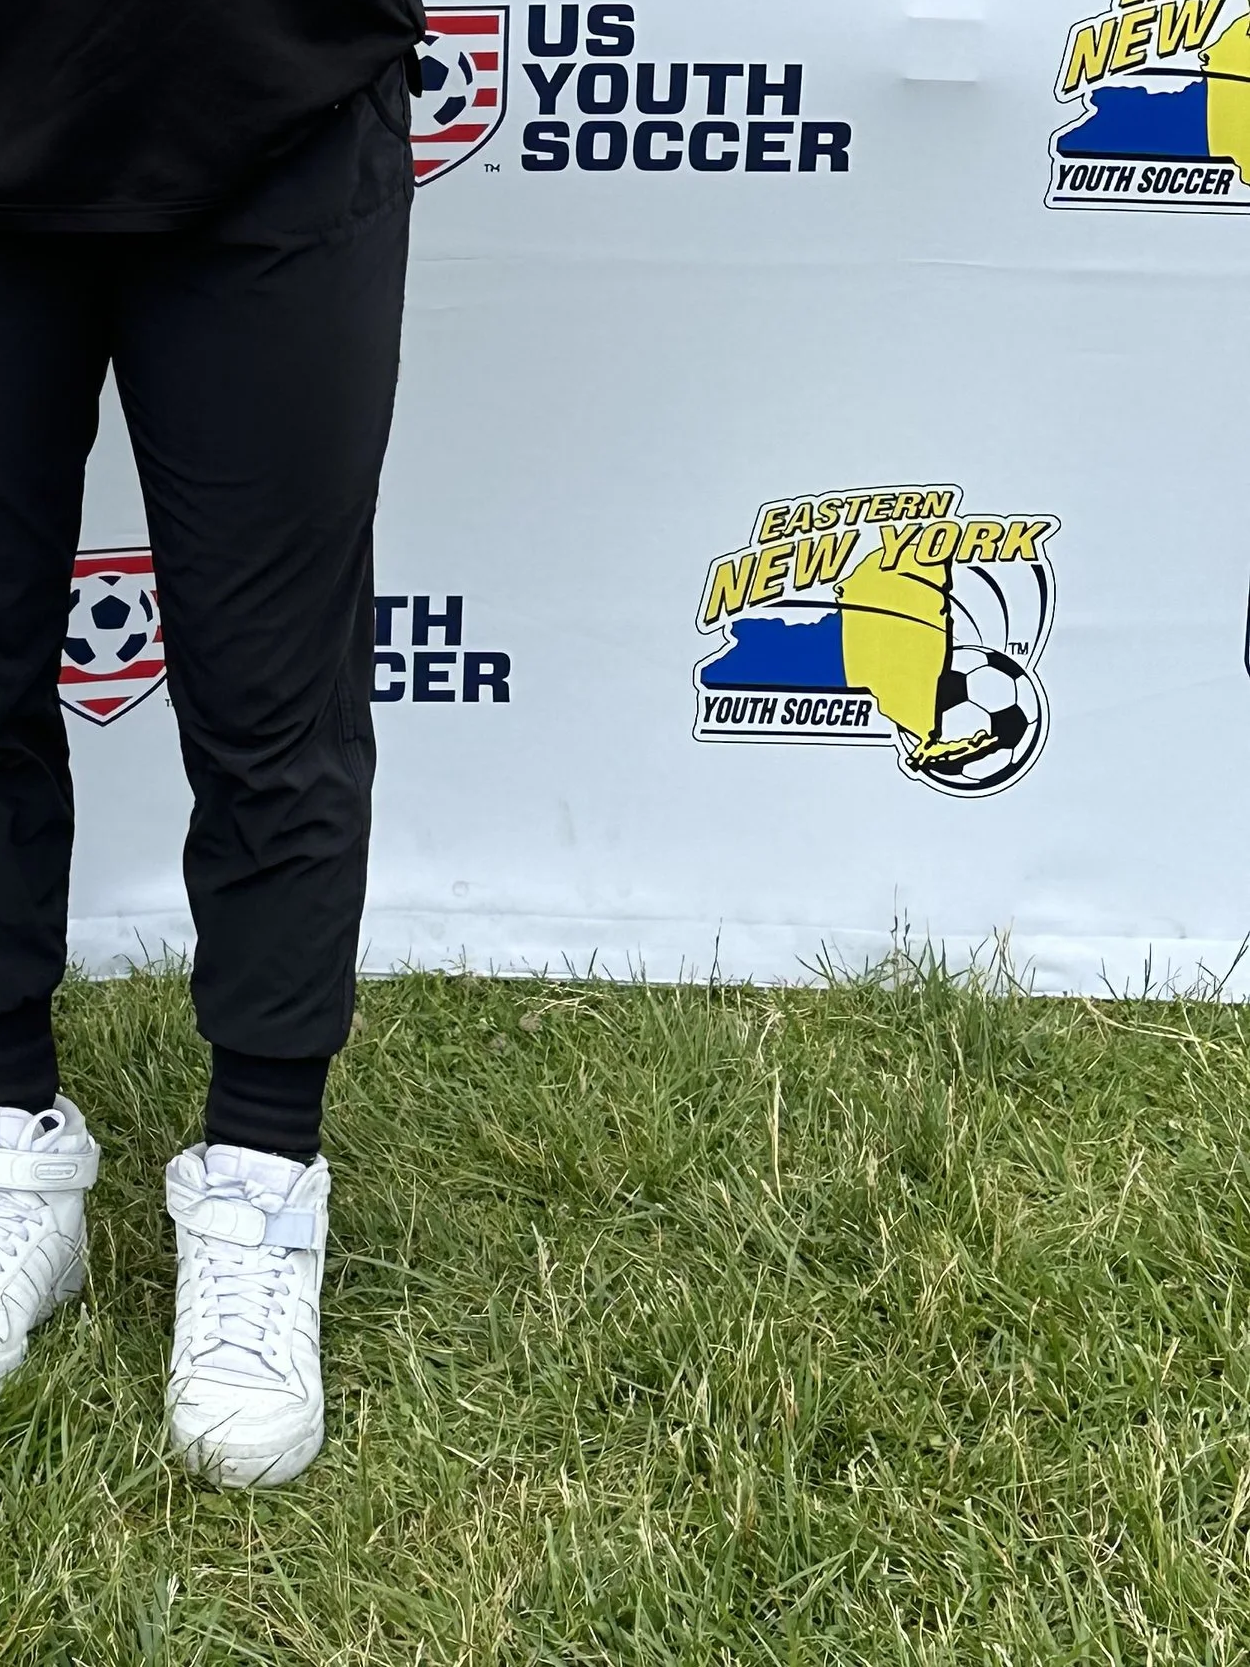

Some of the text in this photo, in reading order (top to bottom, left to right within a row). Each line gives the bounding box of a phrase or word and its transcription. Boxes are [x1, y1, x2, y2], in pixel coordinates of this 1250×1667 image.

[528, 3, 635, 58] US
[522, 62, 803, 115] YOUTH
[521, 120, 852, 172] SOCCER
[1057, 164, 1235, 195] YOUTH SOCCER
[758, 491, 953, 545] EASTERN
[704, 521, 1051, 626] NEW YORK
[703, 695, 872, 727] YOUTH SOCCER
